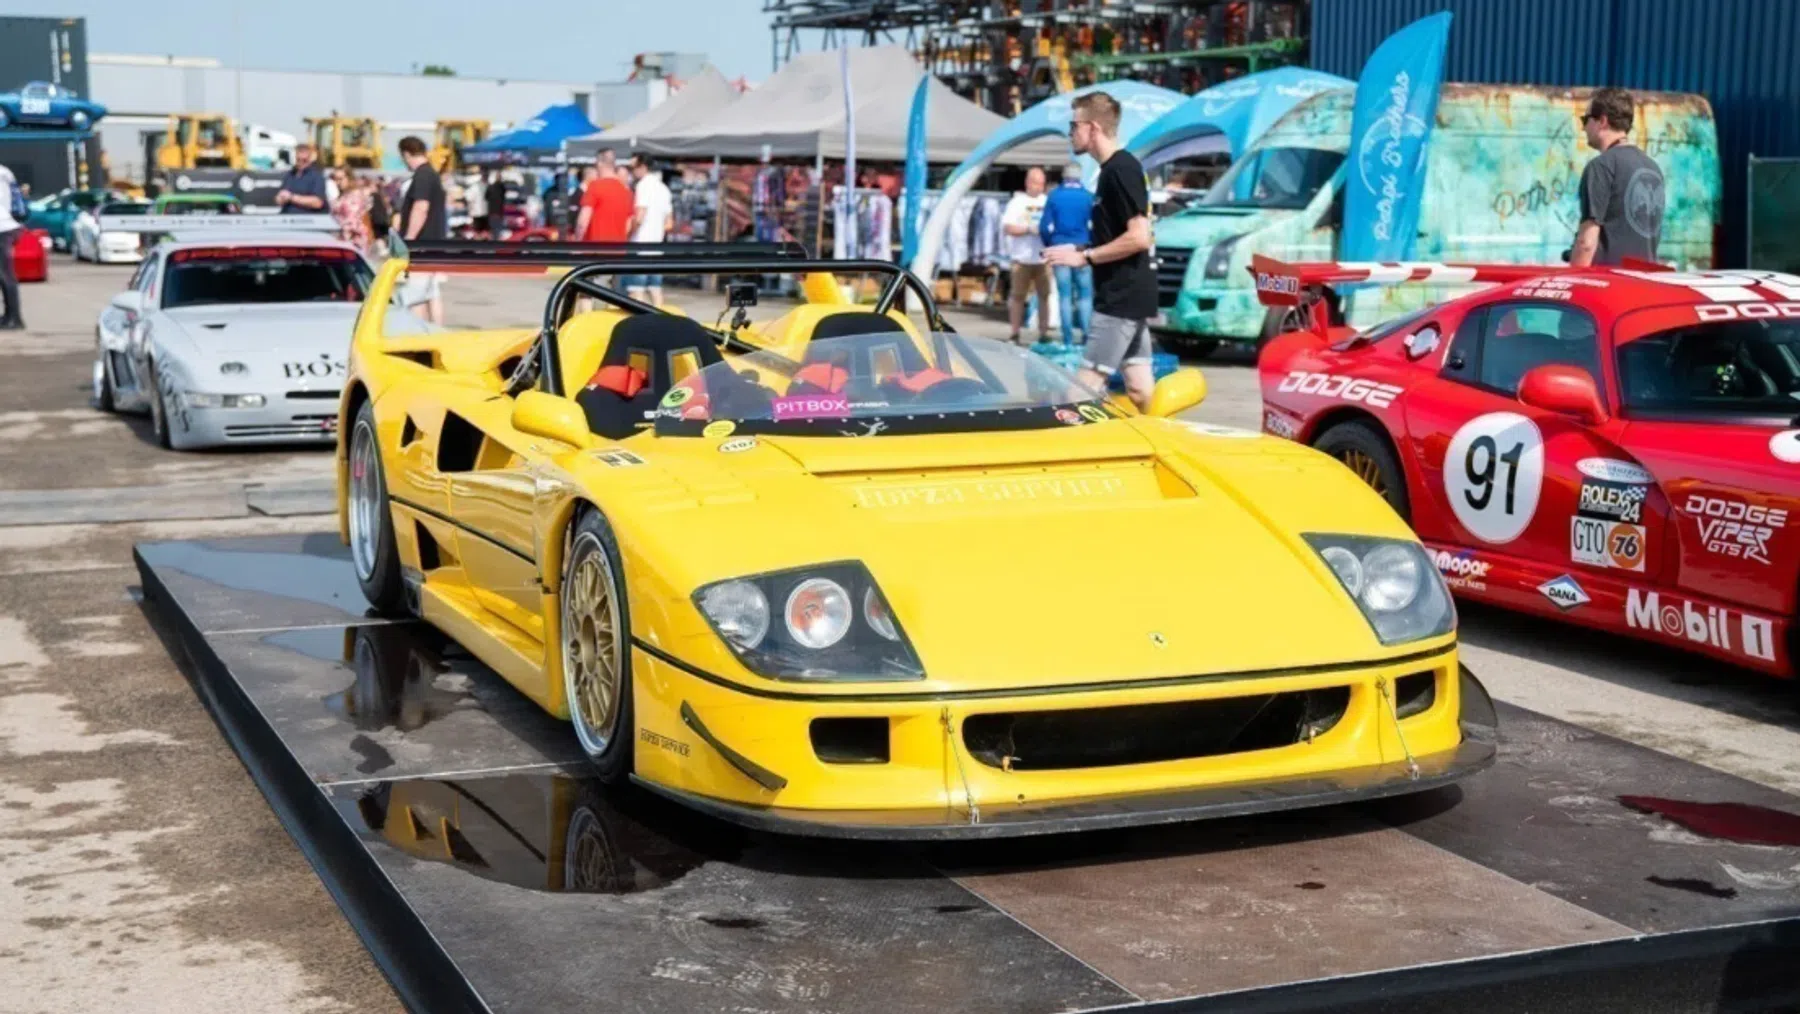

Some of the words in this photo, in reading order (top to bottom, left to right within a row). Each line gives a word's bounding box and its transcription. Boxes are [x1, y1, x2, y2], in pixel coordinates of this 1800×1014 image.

[775, 399, 848, 414] PITBOX
[1277, 371, 1405, 409] DODGE
[1464, 435, 1525, 515] 91
[1581, 484, 1629, 507] ROLEX
[1620, 500, 1640, 523] 24
[1685, 494, 1788, 528] DODGE
[1573, 518, 1606, 554] GTO
[1612, 534, 1639, 558] 76
[1696, 515, 1774, 556] VIPER
[1707, 539, 1742, 557] GTS
[1742, 546, 1772, 565] R
[1549, 587, 1578, 602] DANA
[1626, 587, 1731, 650] Mobil
[1750, 622, 1764, 657] 1
